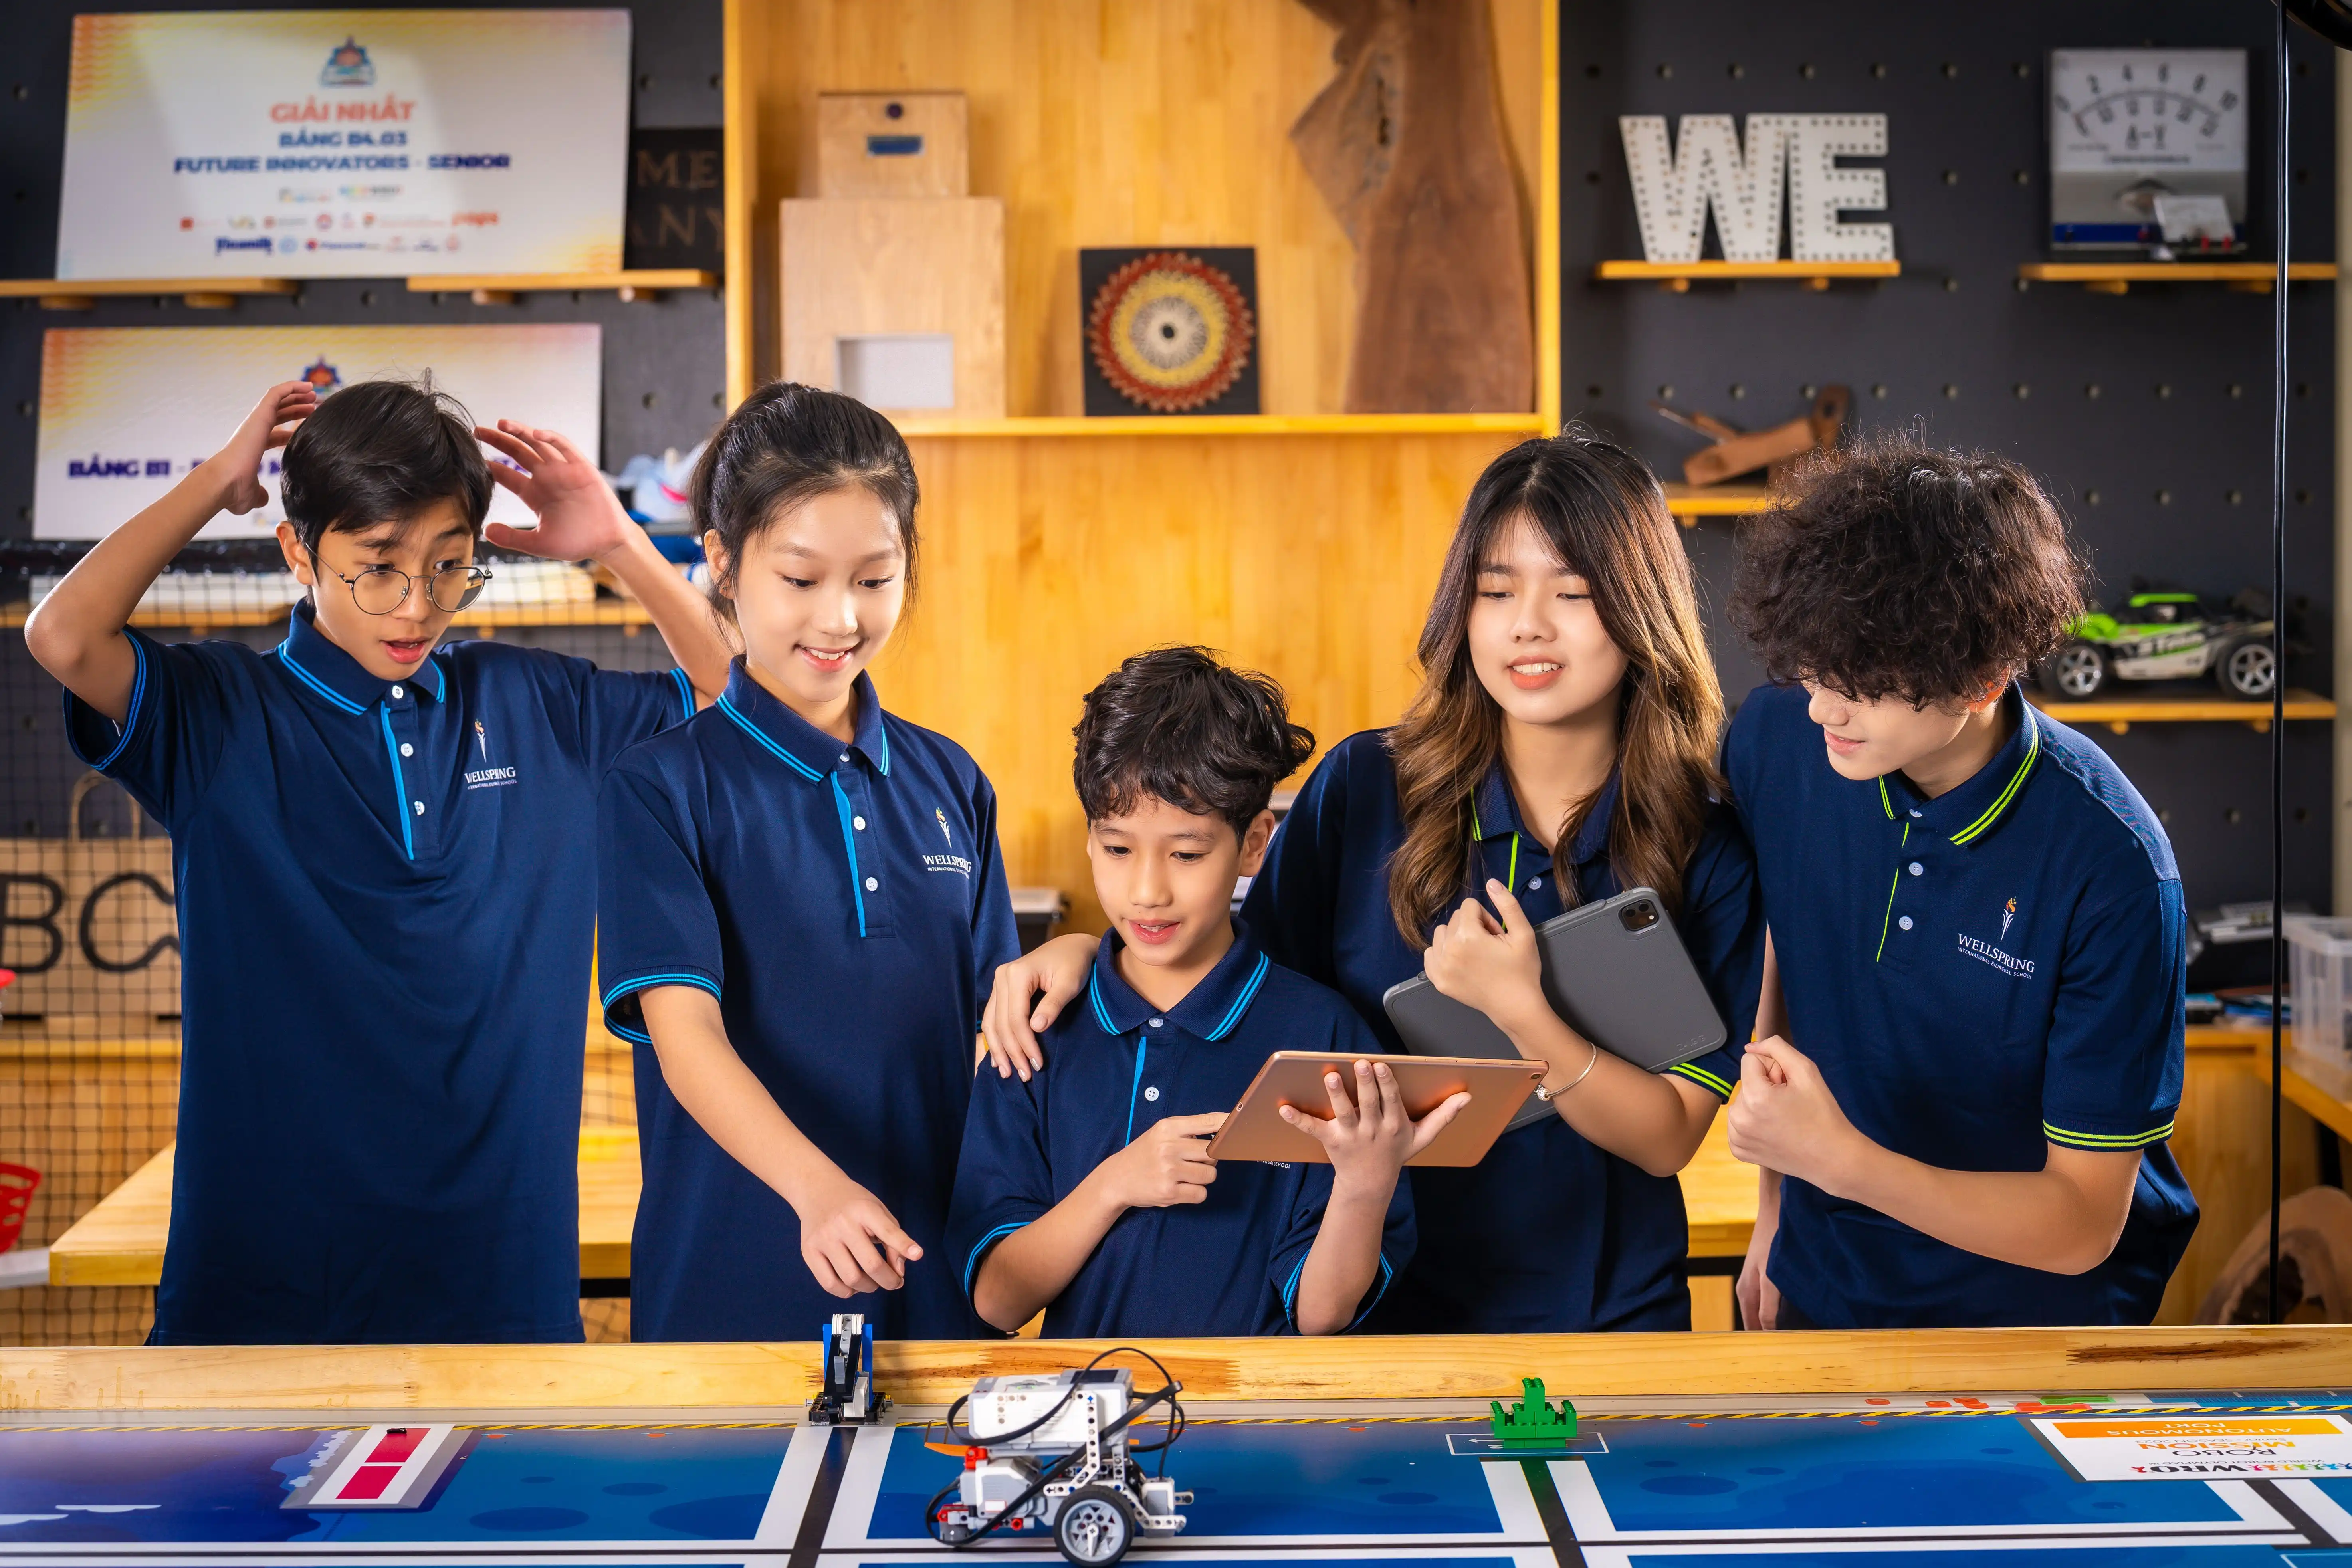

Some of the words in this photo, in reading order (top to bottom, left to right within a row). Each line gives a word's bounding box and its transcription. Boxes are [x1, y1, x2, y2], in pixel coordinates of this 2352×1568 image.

[271, 94, 329, 123] GIẢI
[173, 156, 260, 173] FUTURE
[266, 155, 409, 170] INNOVATORS
[428, 154, 510, 170] SENIOR
[1618, 113, 1895, 263] WE
[68, 453, 140, 477] BẢNG
[1957, 946, 1990, 965] INTERNATIONAL
[1991, 961, 2011, 975] BILINGUAL
[2013, 971, 2032, 980] SCHOOL
[1958, 933, 2035, 973] WELLSPRING
